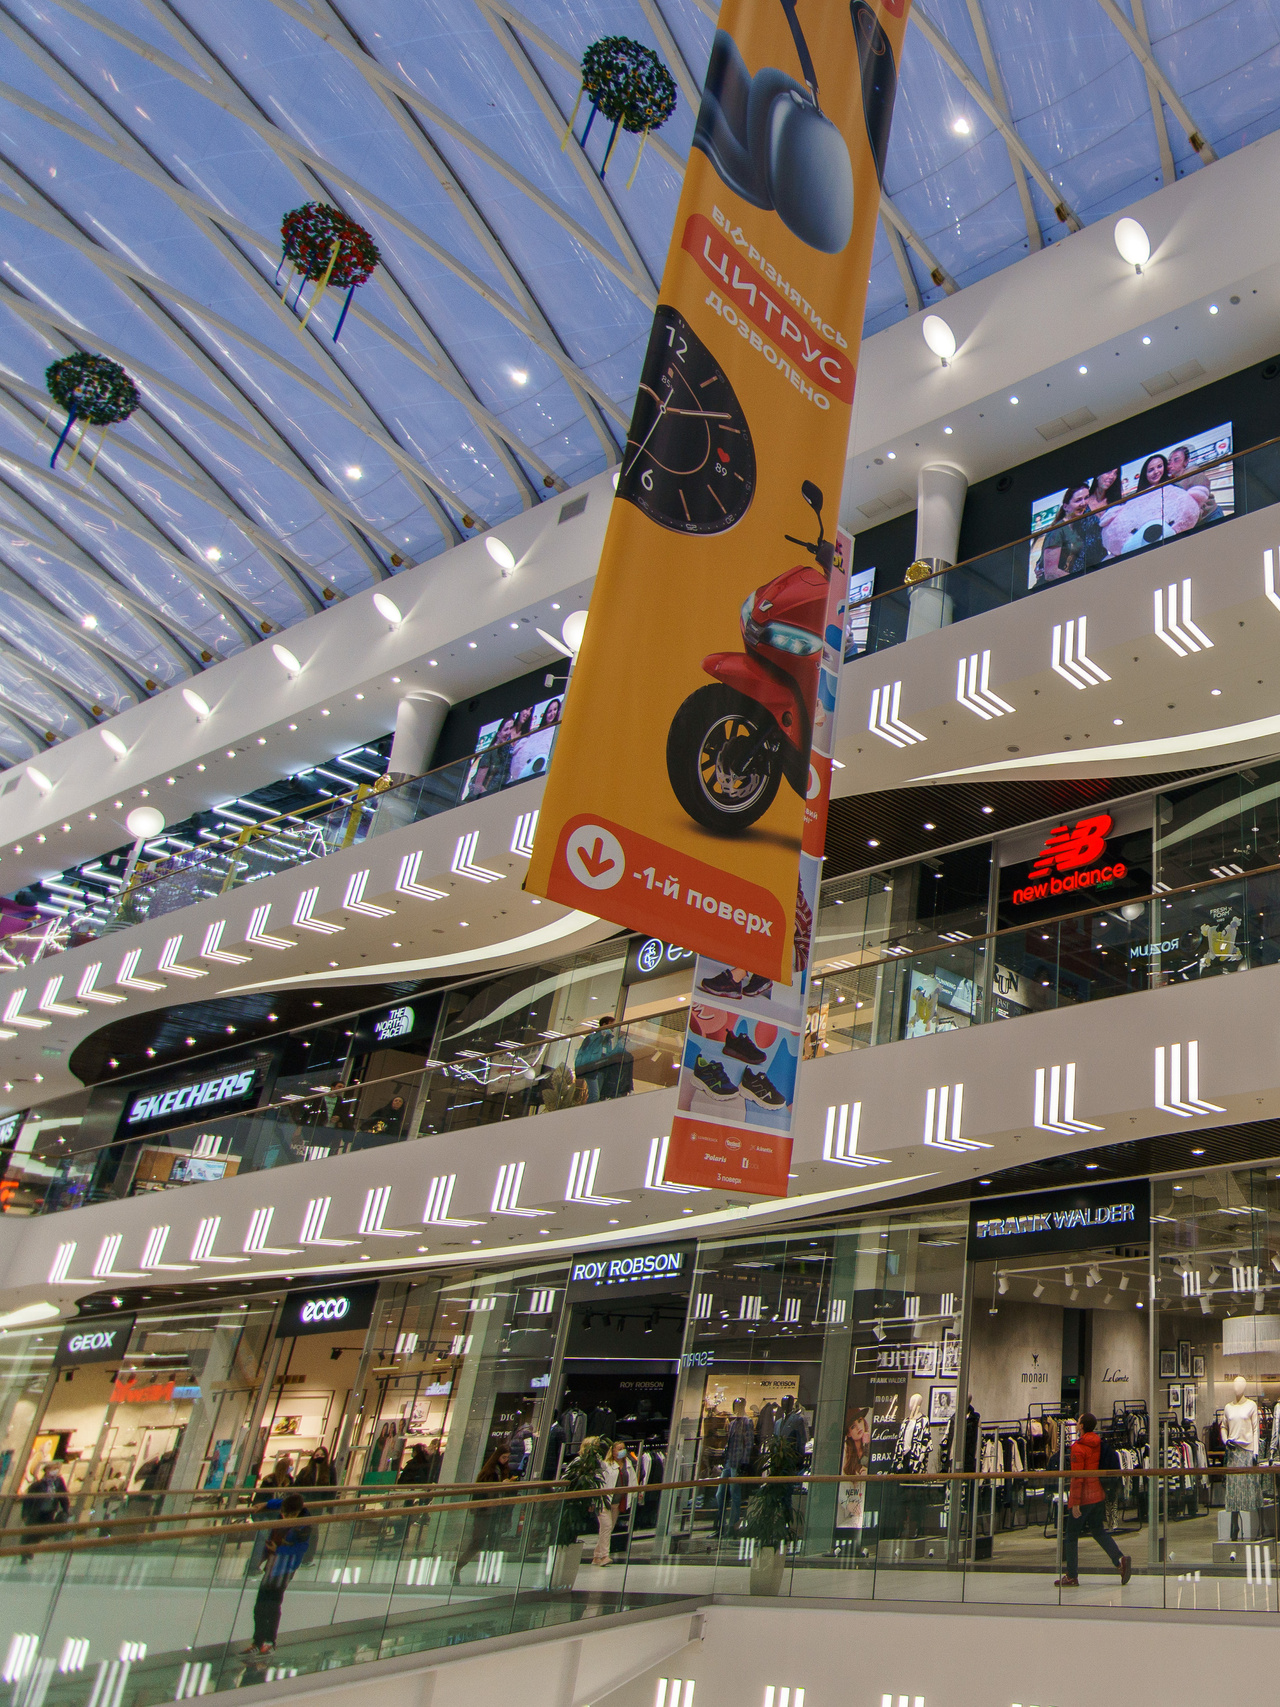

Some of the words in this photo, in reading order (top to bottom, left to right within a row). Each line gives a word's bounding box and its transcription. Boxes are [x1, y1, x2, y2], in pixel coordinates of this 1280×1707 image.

[703, 234, 842, 384] ЦИТРУС
[666, 325, 688, 363] 12
[705, 290, 830, 410] ДОЗВОЛЕНО
[641, 469, 654, 491] 6
[1013, 882, 1049, 905] new
[1050, 863, 1128, 895] balance
[632, 866, 680, 900] -1-й
[686, 889, 773, 937] поверх
[374, 1016, 402, 1032] NORTH
[389, 1007, 406, 1019] THE
[378, 1026, 402, 1040] FACE
[128, 1070, 256, 1124] SKECHERS
[976, 1212, 1052, 1238] FRANK
[1053, 1203, 1135, 1229] WALDER
[572, 1261, 606, 1281] ROY
[608, 1253, 684, 1277] ROBSON
[301, 1297, 349, 1323] ecco
[68, 1331, 117, 1353] GEOX
[635, 1381, 665, 1389] ROBSON
[871, 1453, 891, 1462] BRAX
[845, 1488, 859, 1496] NEW
